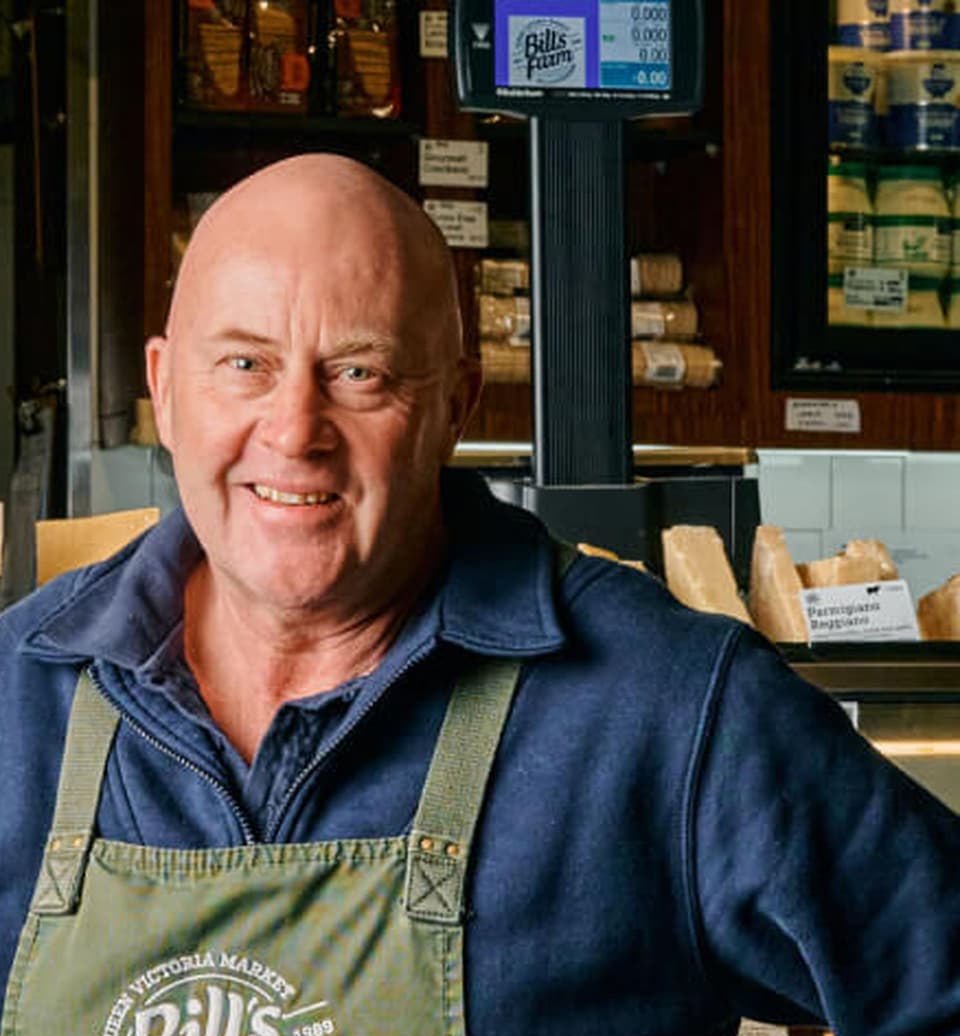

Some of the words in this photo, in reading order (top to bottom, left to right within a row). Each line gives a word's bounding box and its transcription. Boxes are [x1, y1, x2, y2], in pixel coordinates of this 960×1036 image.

[807, 602, 881, 619] Parmigiano
[809, 616, 870, 631] Reggiano
[129, 952, 215, 996] VICTORIA
[219, 952, 297, 1000] MARKET
